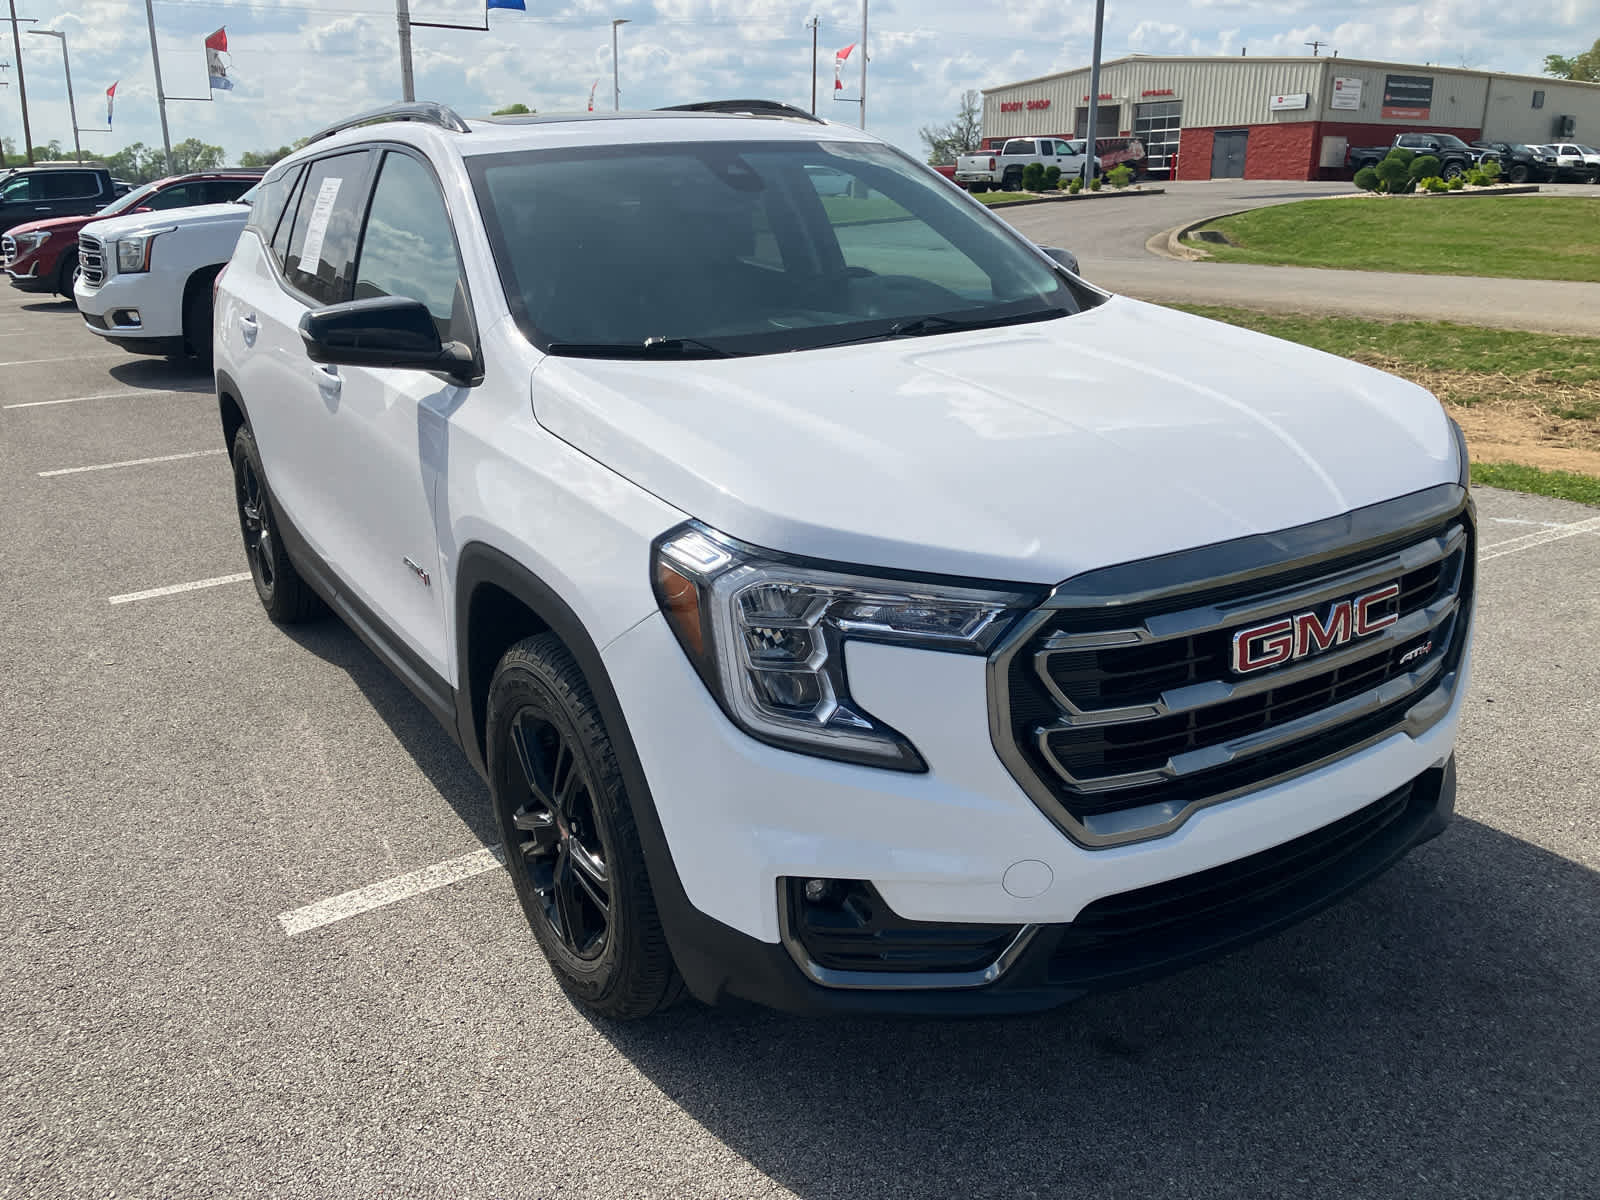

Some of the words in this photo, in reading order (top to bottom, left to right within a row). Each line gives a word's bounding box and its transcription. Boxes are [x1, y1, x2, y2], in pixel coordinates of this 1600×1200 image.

[1000, 102, 1023, 112] BODY
[1026, 99, 1051, 110] SHOP
[1232, 583, 1400, 673] GMC
